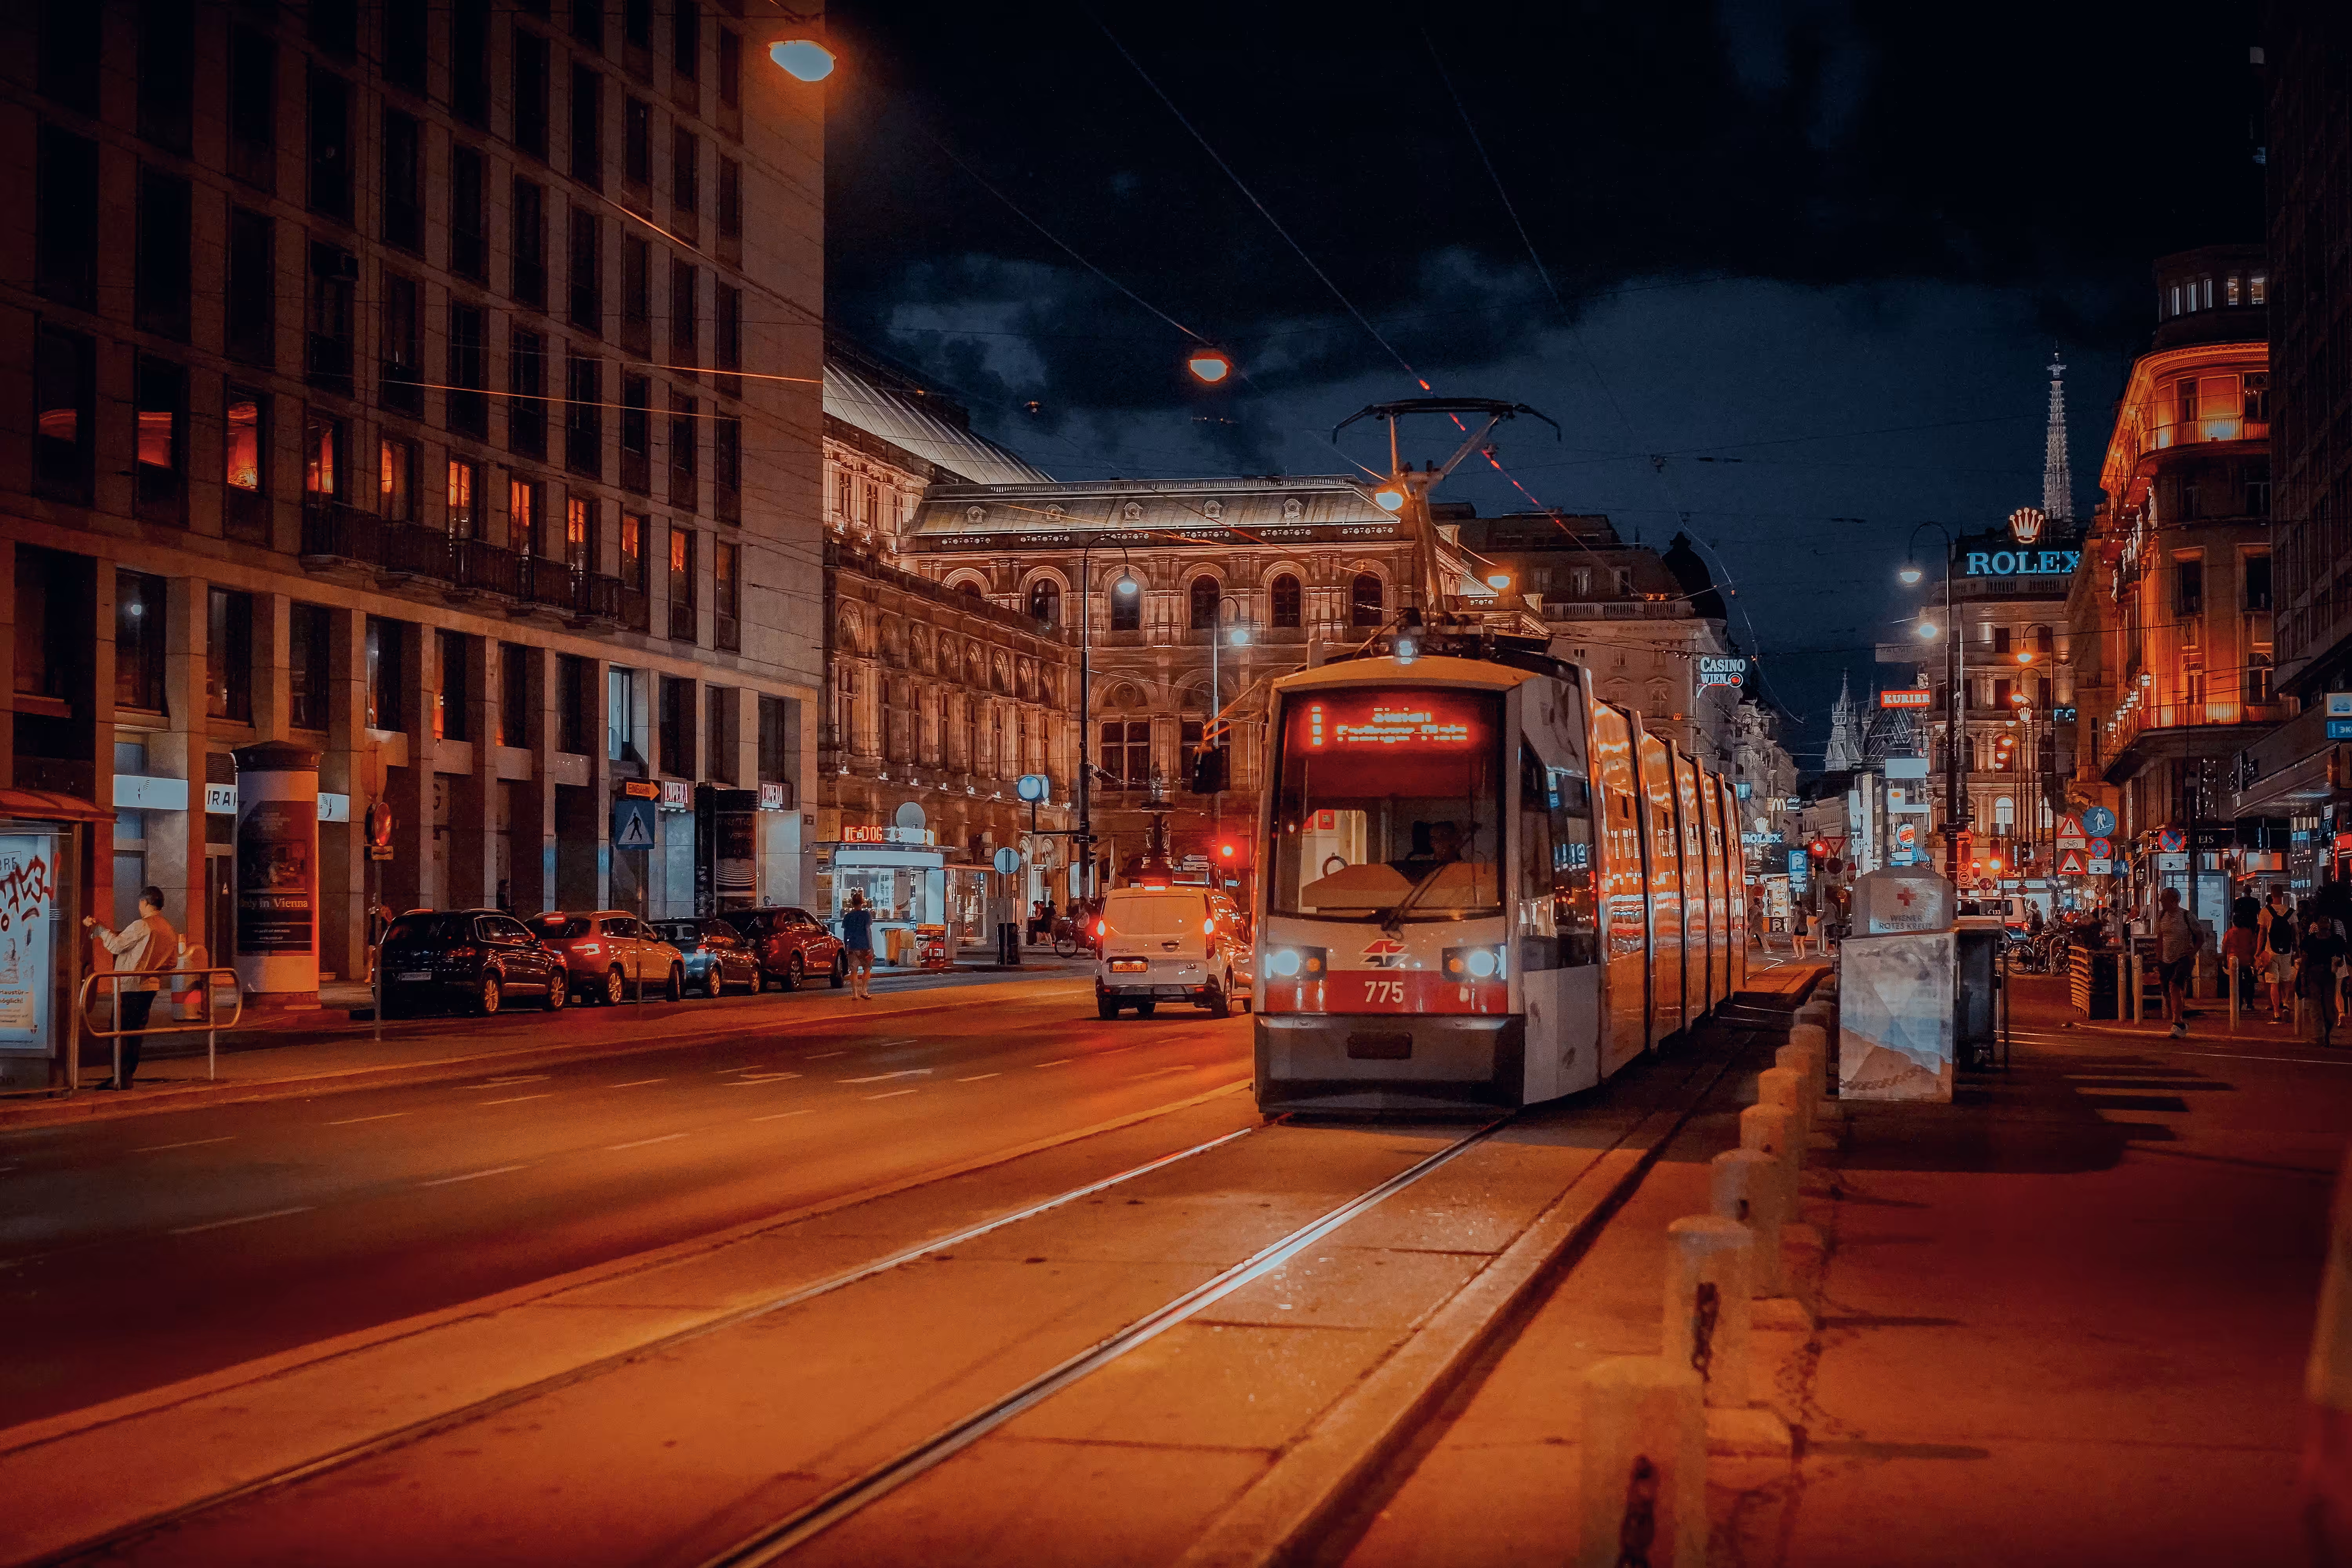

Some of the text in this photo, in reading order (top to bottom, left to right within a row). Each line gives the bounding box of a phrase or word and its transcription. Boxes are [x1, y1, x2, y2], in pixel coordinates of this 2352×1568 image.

[1967, 551, 2080, 574] ROLEX
[1700, 657, 1746, 672] CASINO
[1700, 674, 1727, 684] WIEN
[1884, 694, 1930, 703] KURIER
[862, 826, 883, 841] DOG
[1741, 834, 1782, 843] ROLEX
[1900, 833, 1914, 841] KIN
[274, 897, 309, 908] Vienna
[1365, 981, 1404, 1004] 775
